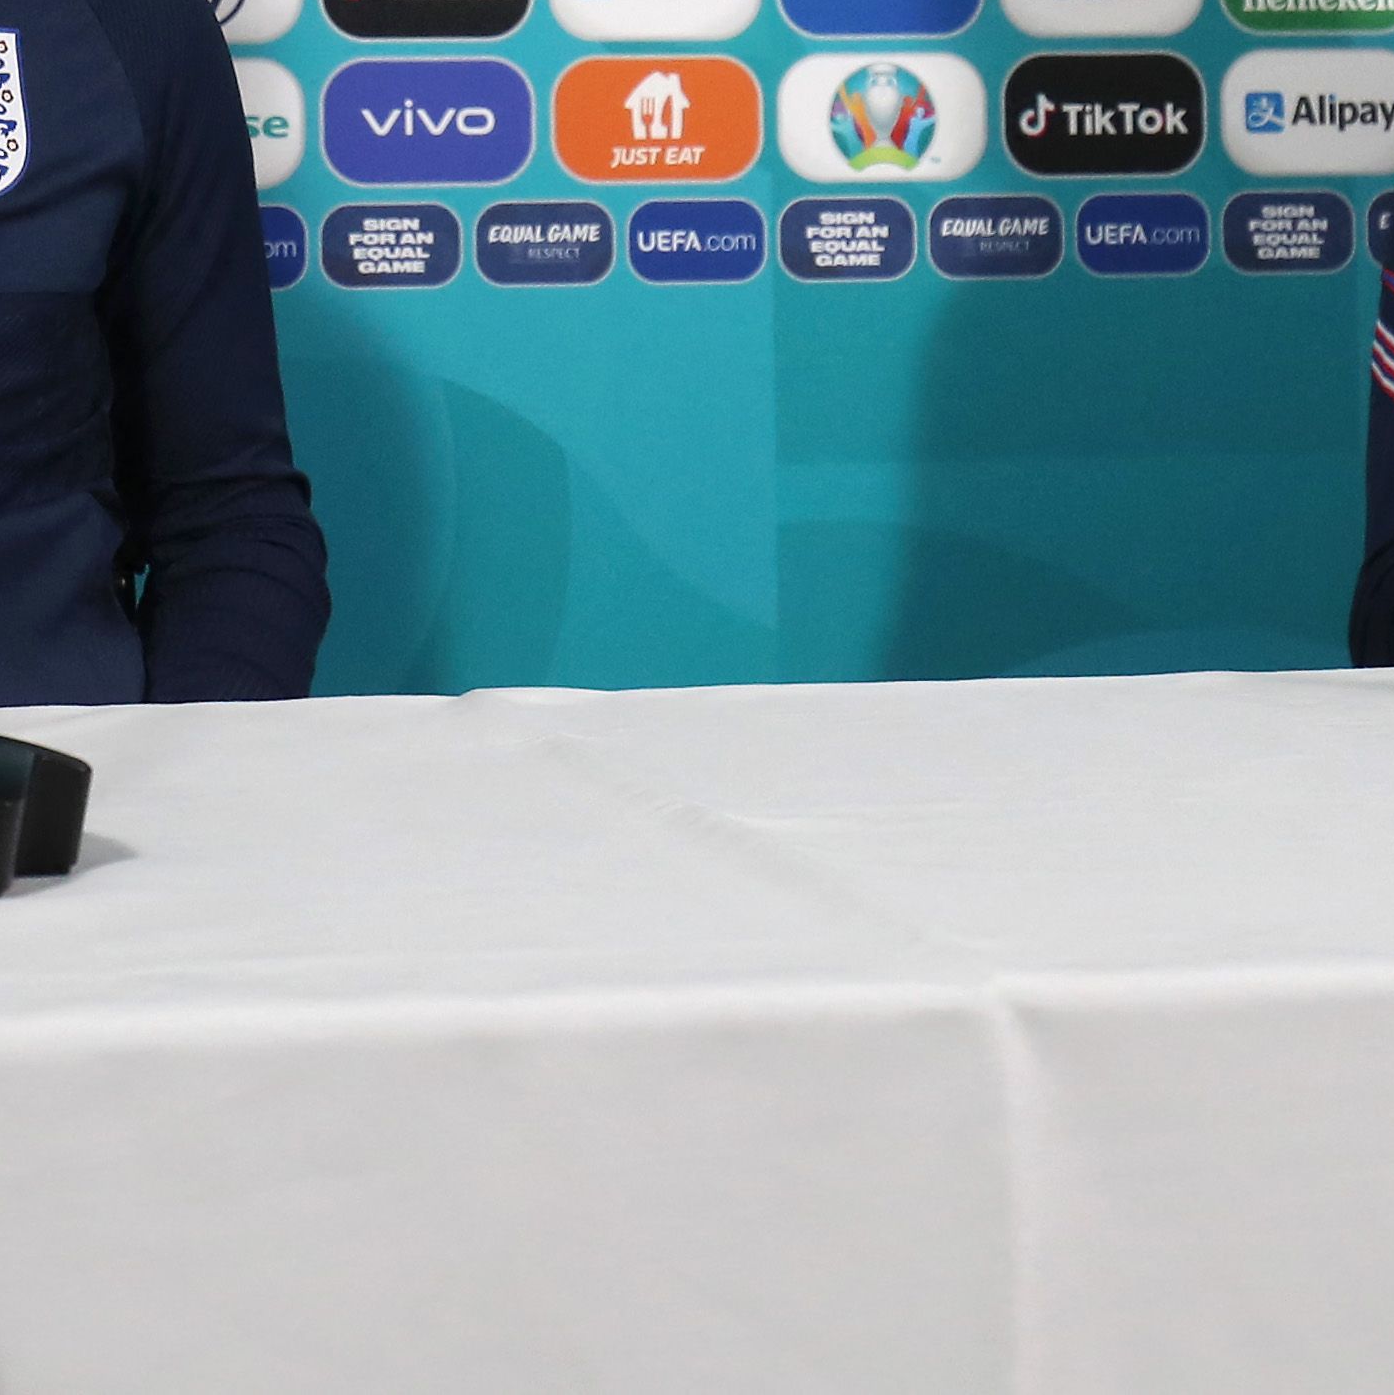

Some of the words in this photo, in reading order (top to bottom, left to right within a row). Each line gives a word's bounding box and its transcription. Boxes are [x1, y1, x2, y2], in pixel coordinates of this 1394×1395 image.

[362, 99, 495, 136] vivo
[1062, 103, 1188, 135] TikTok
[611, 146, 661, 168] JUST
[665, 146, 705, 165] EAT
[363, 218, 419, 231] SIGN
[819, 212, 874, 225] SIGN
[488, 225, 545, 244] EQUAL
[547, 224, 600, 243] GAME
[805, 226, 853, 239] FOR
[856, 225, 888, 239] AN
[941, 218, 995, 237] EQUAL
[999, 218, 1049, 236] GAME
[1085, 223, 1199, 245] UEFA.com
[349, 232, 396, 245] FOR
[401, 231, 433, 245] AN
[637, 230, 756, 252] UEFA.com
[353, 246, 430, 260] EQUAL
[810, 240, 885, 253] EQUAL
[358, 260, 424, 273] GAME
[816, 253, 880, 266] GAME
